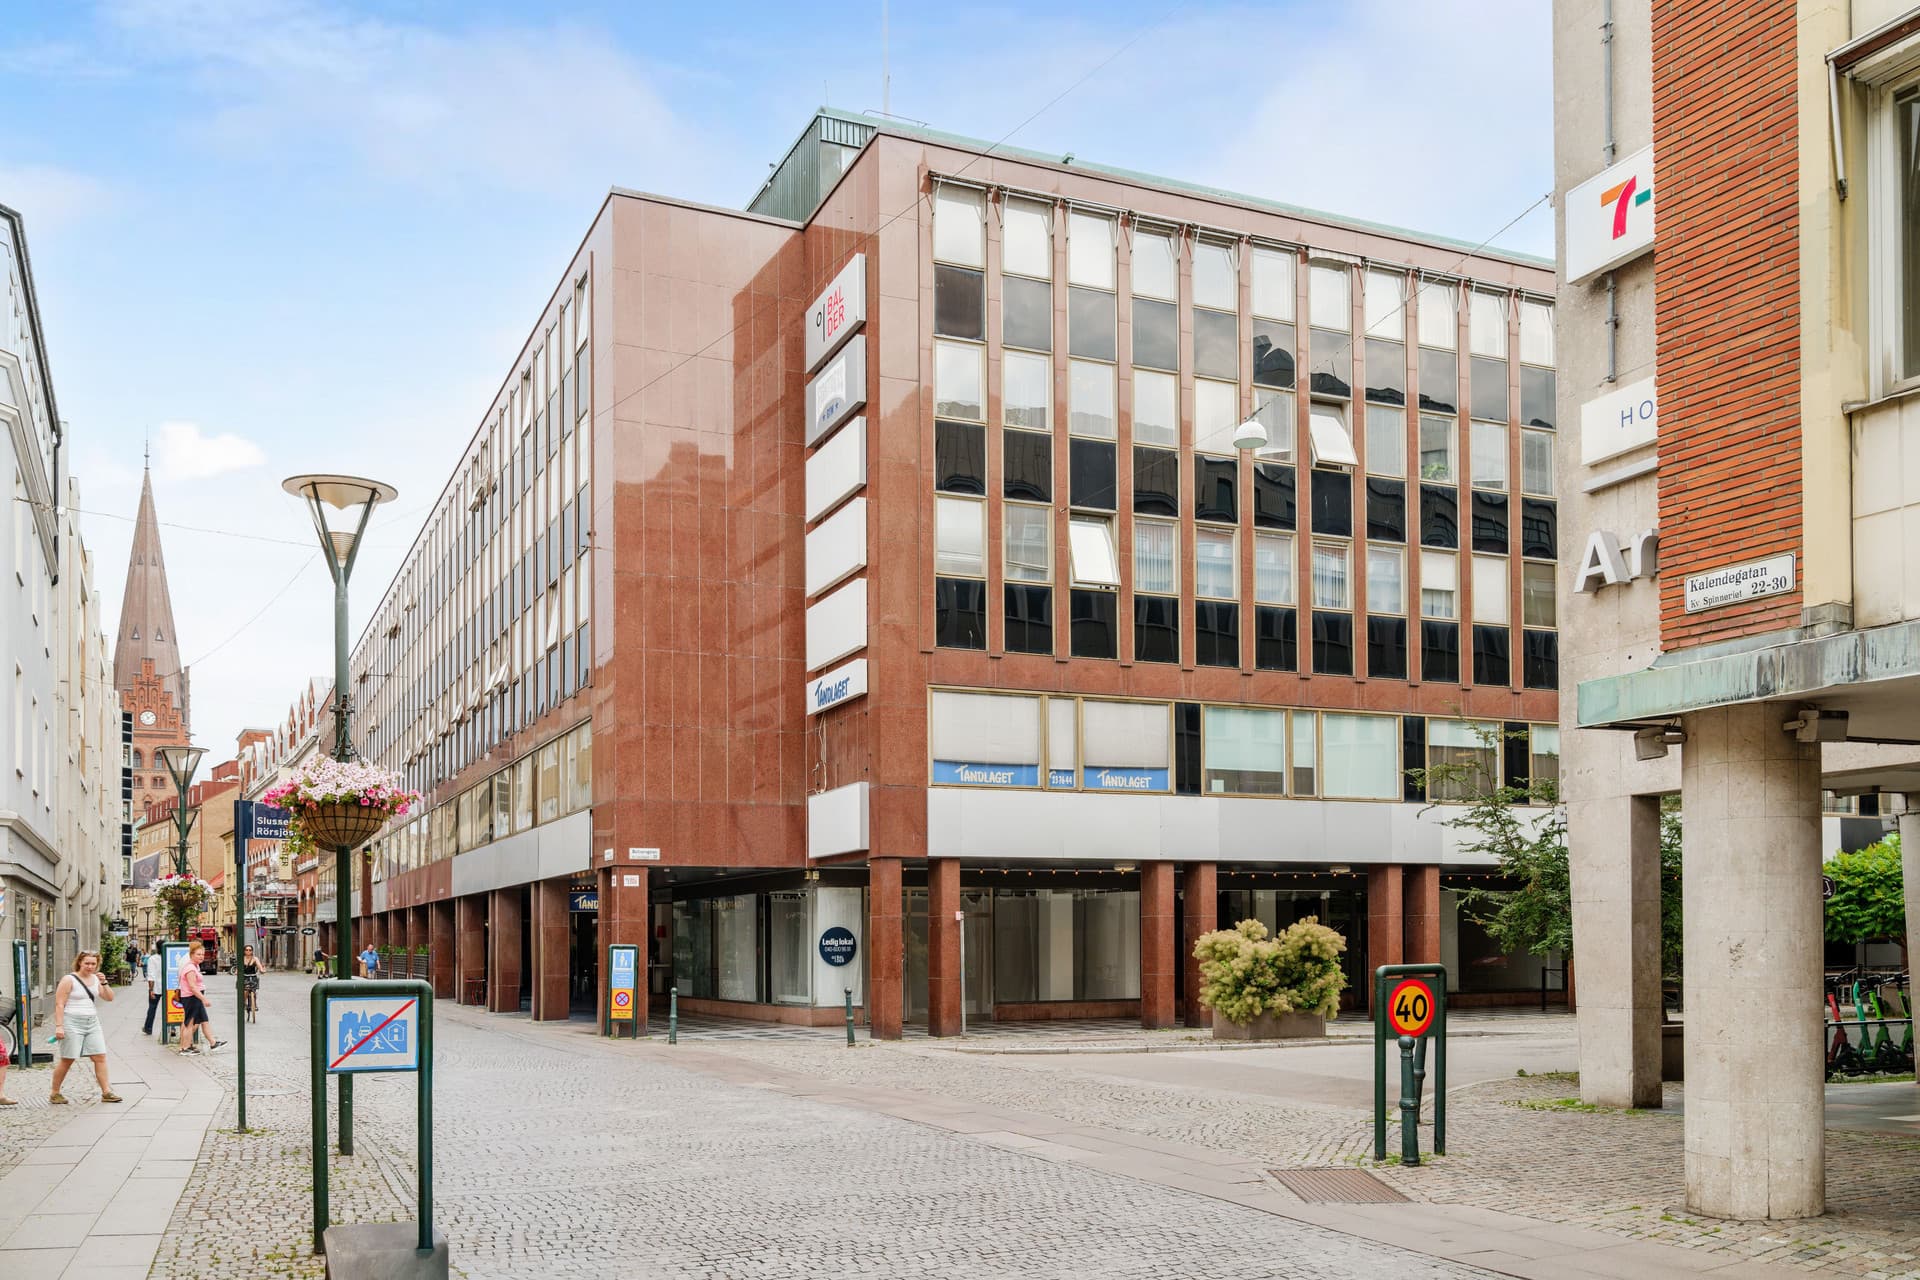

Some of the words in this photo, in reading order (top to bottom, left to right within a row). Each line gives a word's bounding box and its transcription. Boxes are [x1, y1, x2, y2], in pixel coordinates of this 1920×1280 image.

[827, 286, 844, 315] BAL
[827, 304, 846, 337] DER
[1621, 399, 1654, 428] HO
[1690, 566, 1768, 593] Kalendegatan
[1751, 576, 1787, 595] 22-30
[1703, 590, 1742, 607] Spinneriet
[954, 764, 1014, 784] TANDLAGET
[1097, 769, 1152, 788] TANDLAGET
[839, 937, 854, 946] lokal
[1395, 994, 1428, 1023] 40
